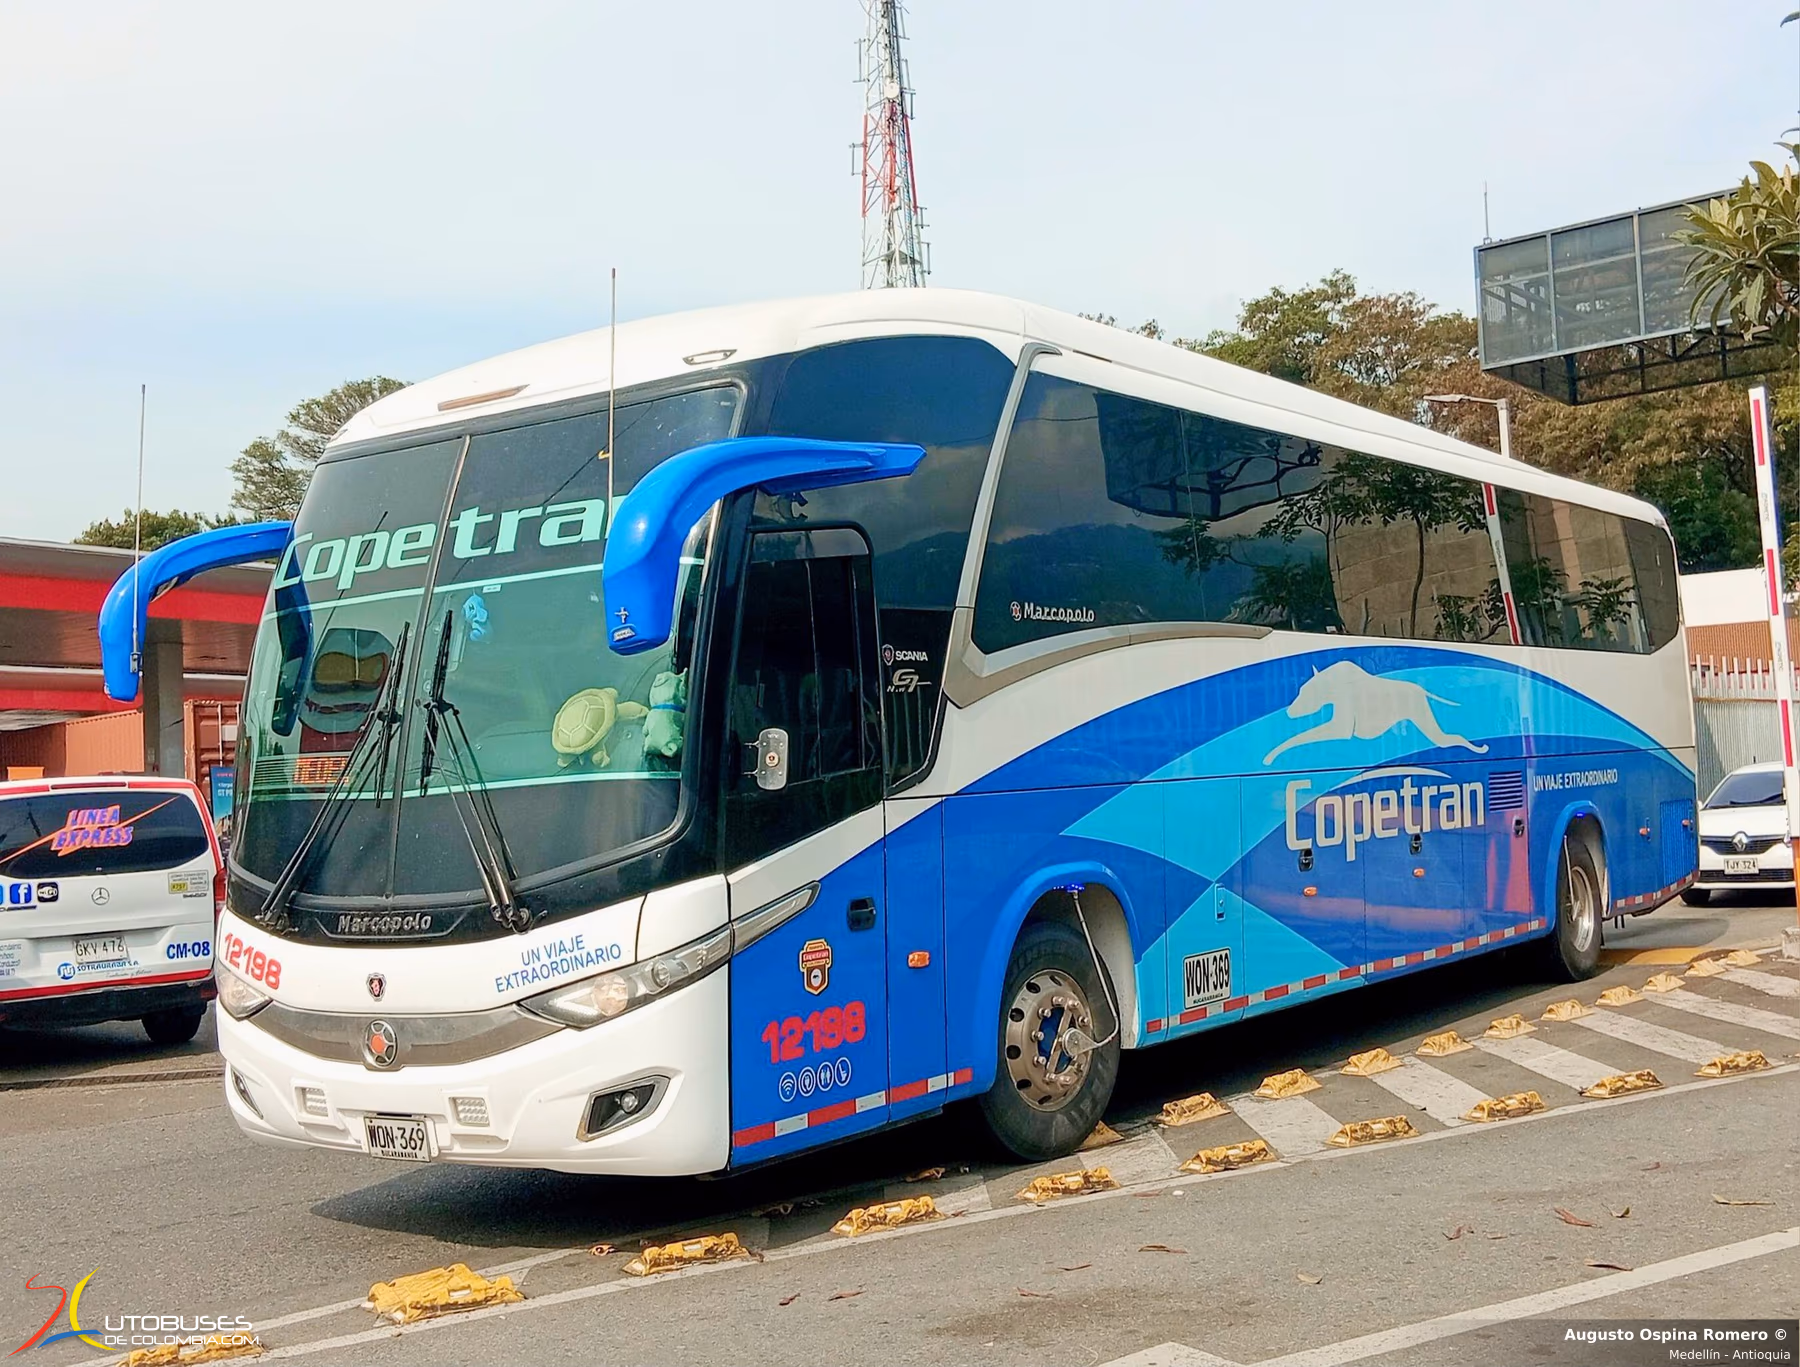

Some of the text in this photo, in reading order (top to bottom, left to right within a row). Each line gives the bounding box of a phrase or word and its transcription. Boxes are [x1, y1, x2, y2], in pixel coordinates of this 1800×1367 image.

[1023, 601, 1095, 624] Marcopolo
[895, 650, 929, 661] SCANIA
[1533, 768, 1618, 792] UN VIAJE EXTRAORDINARIO
[70, 808, 119, 826] LINEA
[1285, 776, 1485, 862] Copetran
[55, 826, 134, 848] EXPRESS
[337, 912, 432, 933] Marcopolo
[75, 937, 125, 957] GKV 476
[521, 934, 585, 966] UN VIAJE
[224, 932, 282, 990] 12198
[495, 943, 621, 993] EXTRAORDINARIO
[761, 1000, 866, 1065] 12198
